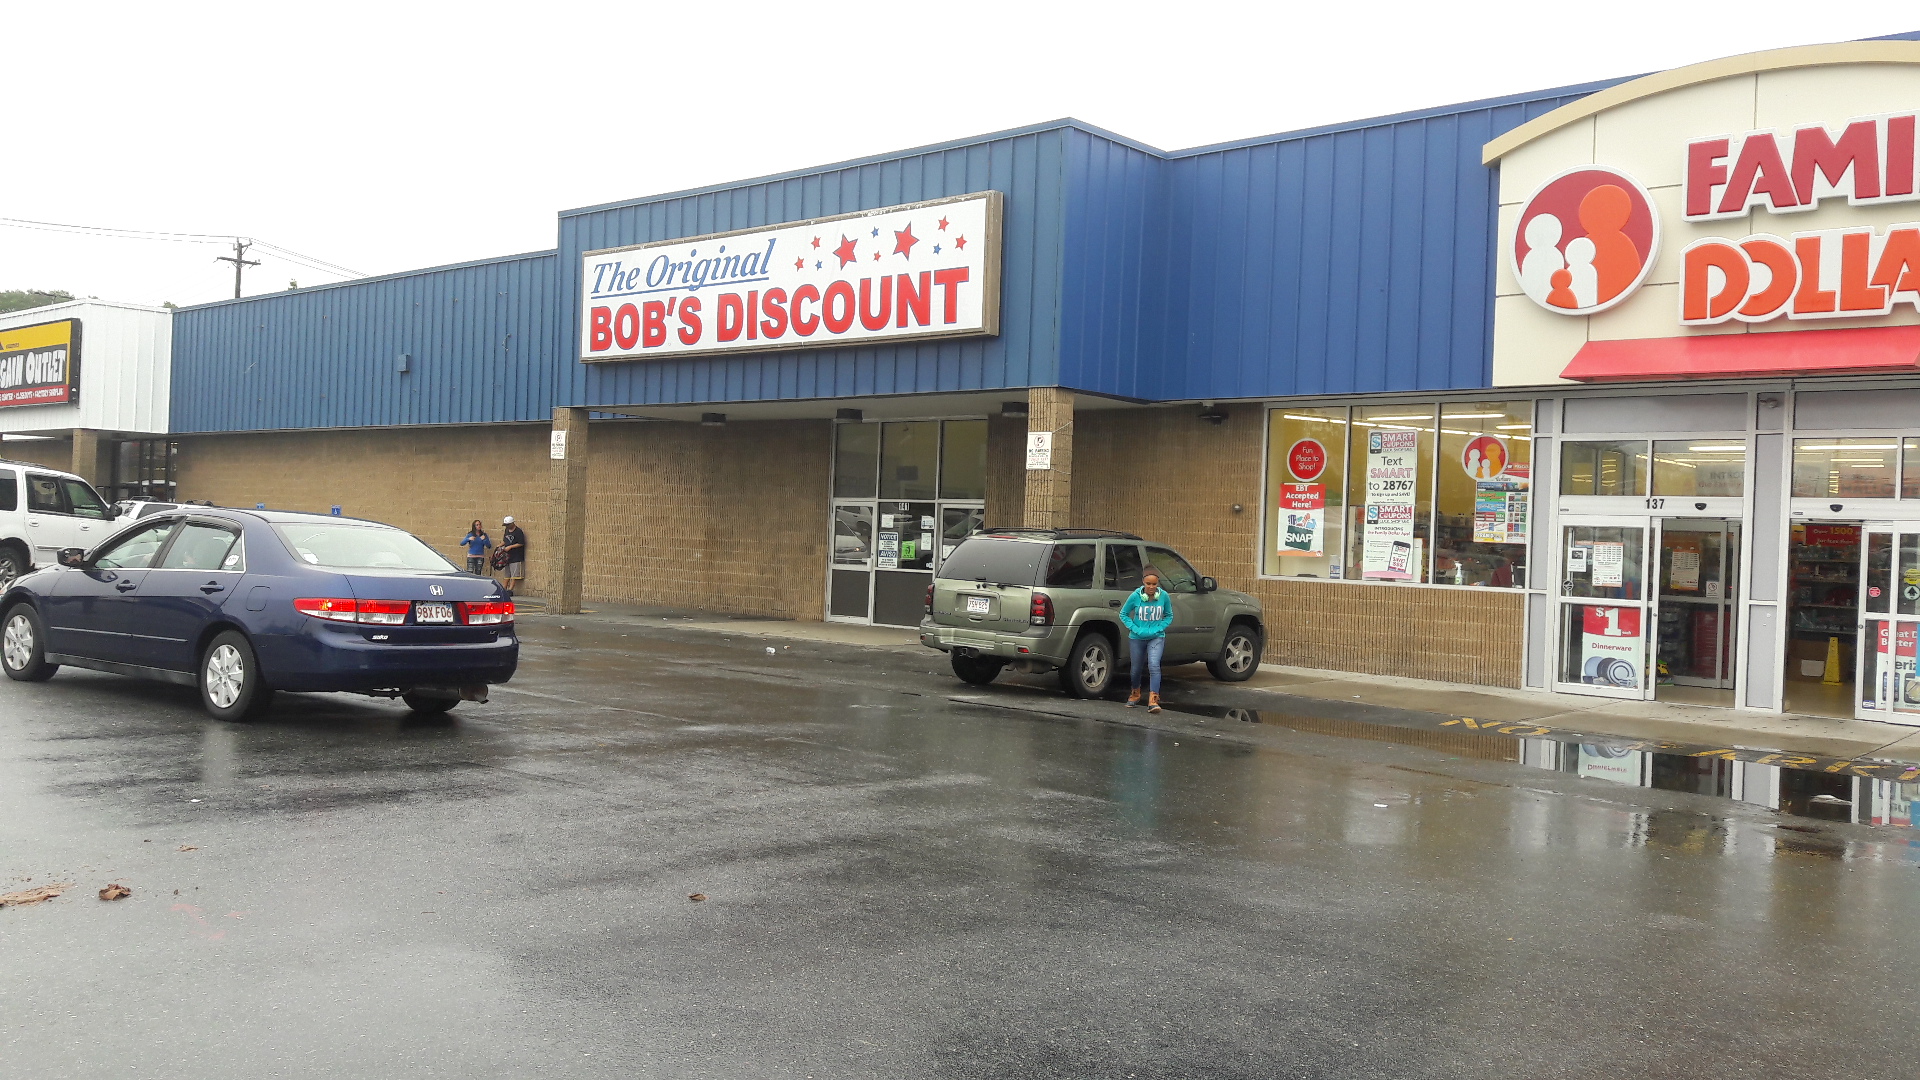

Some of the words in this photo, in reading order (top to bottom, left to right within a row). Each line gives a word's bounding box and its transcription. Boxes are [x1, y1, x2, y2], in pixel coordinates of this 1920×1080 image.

[1686, 114, 1916, 217] FAMI
[591, 262, 639, 294] The
[645, 237, 778, 290] Original
[590, 296, 703, 352] BOB'S
[716, 265, 970, 343] DISCOUNT
[26, 350, 67, 385] OUTLET
[1382, 432, 1414, 442] SMART
[1382, 440, 1414, 448] COUPONS
[1302, 446, 1313, 454] Fun
[1295, 454, 1312, 462] Place
[1381, 456, 1403, 466] Text
[1298, 463, 1316, 471] Shop!
[1370, 467, 1414, 479] SMART
[1295, 484, 1309, 492] EBT
[1368, 481, 1380, 491] to
[1382, 480, 1414, 491] 28767
[1285, 491, 1319, 501] Accepted
[1291, 500, 1312, 508] Here!
[1379, 505, 1411, 513] SMART
[1645, 498, 1665, 510] 137
[1285, 532, 1313, 543] SNAP
[417, 606, 434, 619] 98X
[435, 606, 452, 619] F06
[1138, 605, 1163, 621] AERO
[1591, 642, 1633, 652] Dinnerware
